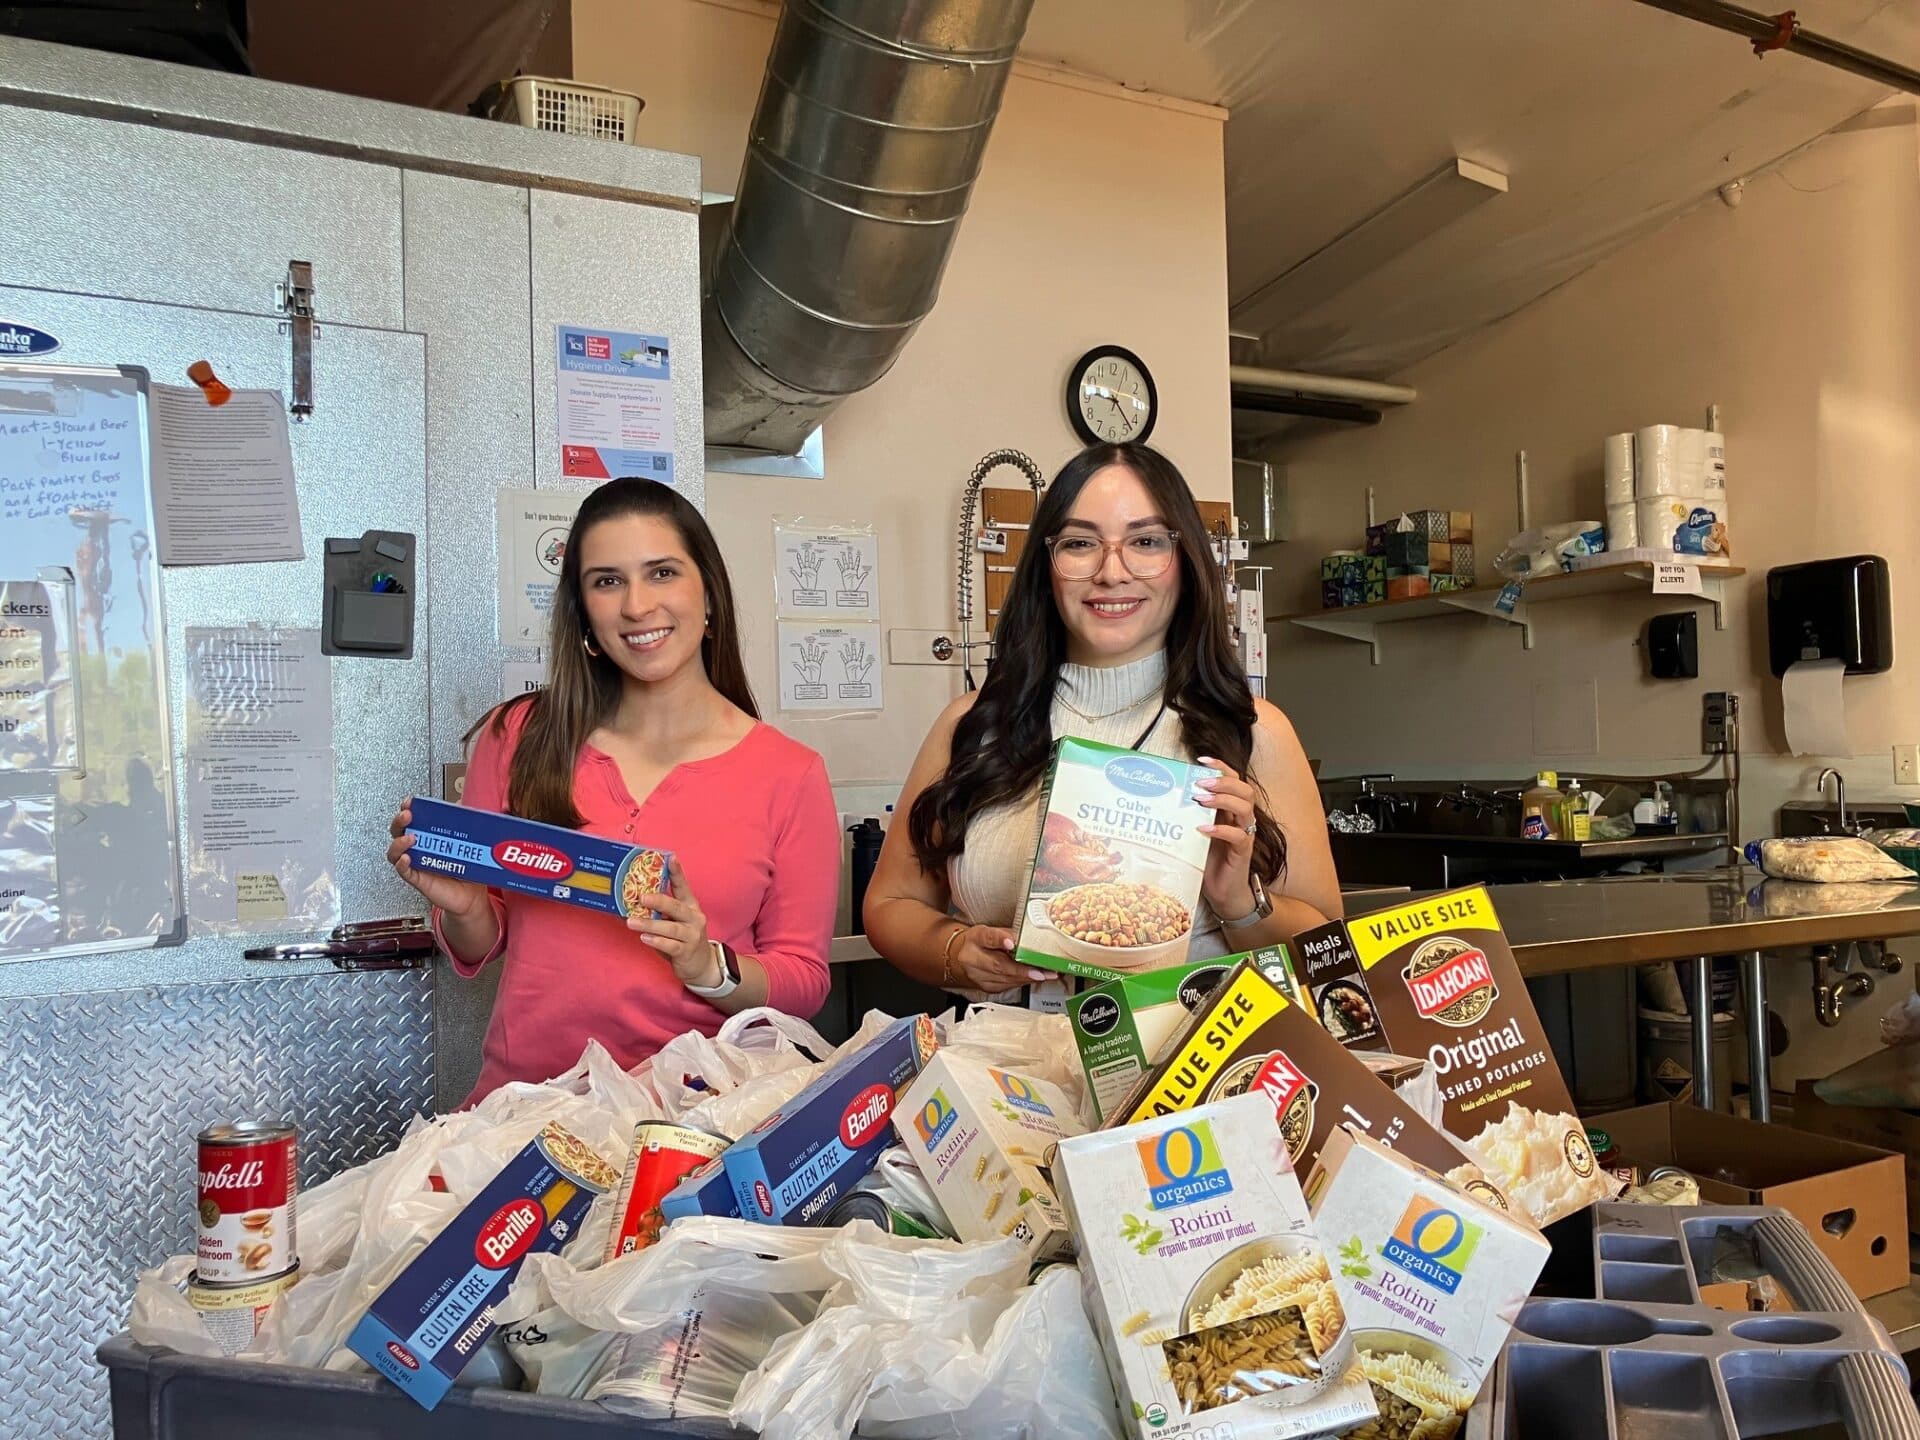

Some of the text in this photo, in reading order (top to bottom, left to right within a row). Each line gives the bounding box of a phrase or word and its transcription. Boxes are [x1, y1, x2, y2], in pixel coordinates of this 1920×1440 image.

[0, 328, 31, 345] nka
[566, 360, 628, 373] Hygiene Drive
[1109, 363, 1118, 376] 12
[1132, 382, 1139, 395] 2
[1087, 407, 1094, 420] 8
[1096, 420, 1104, 433] 7
[1131, 414, 1138, 426] 4
[1108, 426, 1116, 439] 6
[1121, 423, 1129, 436] 5
[0, 601, 49, 614] ckers:
[0, 657, 39, 669] enter
[1116, 797, 1152, 814] Cube
[430, 826, 469, 839] CLASSIC TASTE
[1077, 803, 1184, 841] STUFFING
[413, 833, 483, 861] GLUTEN FREE
[502, 846, 564, 873] Barilla
[421, 856, 466, 875] SPAGHETTI
[1369, 898, 1477, 941] VALUE SIZE
[1304, 935, 1341, 957] Meals
[1067, 963, 1111, 979] NET WT 10 OZ
[1307, 949, 1352, 978] You'll Love
[1413, 956, 1488, 1011] IDAHOAN
[1088, 1042, 1105, 1053] family
[1105, 1033, 1133, 1048] tradition
[1144, 993, 1254, 1120] ALUE SIZE
[1428, 1017, 1525, 1075] Original
[1439, 1051, 1546, 1102] ASHED POTATOES
[847, 1093, 888, 1141] Barilla
[927, 1112, 955, 1150] organics
[679, 1138, 698, 1147] Flavors
[788, 1140, 820, 1170] CLASSIC TASTE
[936, 1124, 967, 1168] Rotini
[781, 1164, 819, 1207] GLUTEN
[819, 1145, 840, 1176] FREE
[1156, 1174, 1226, 1203] organics
[756, 1185, 771, 1214] Barilla
[801, 1181, 838, 1222] SPAGHETTI
[483, 1207, 536, 1262] Barilla
[1169, 1204, 1234, 1237] Rotini
[1158, 1222, 1256, 1257] organic macaroni product
[1389, 1244, 1455, 1288] organics
[419, 1277, 455, 1314] CLASSIC TASTE
[1378, 1270, 1438, 1315] Rotini
[419, 1273, 489, 1349] GLUTEN FREE
[1354, 1280, 1446, 1338] organic macaroni product
[375, 1351, 399, 1372] GLUTEN
[389, 1344, 416, 1367] Barilla
[1151, 1431, 1162, 1439] PER
[1170, 1425, 1180, 1434] CUP
